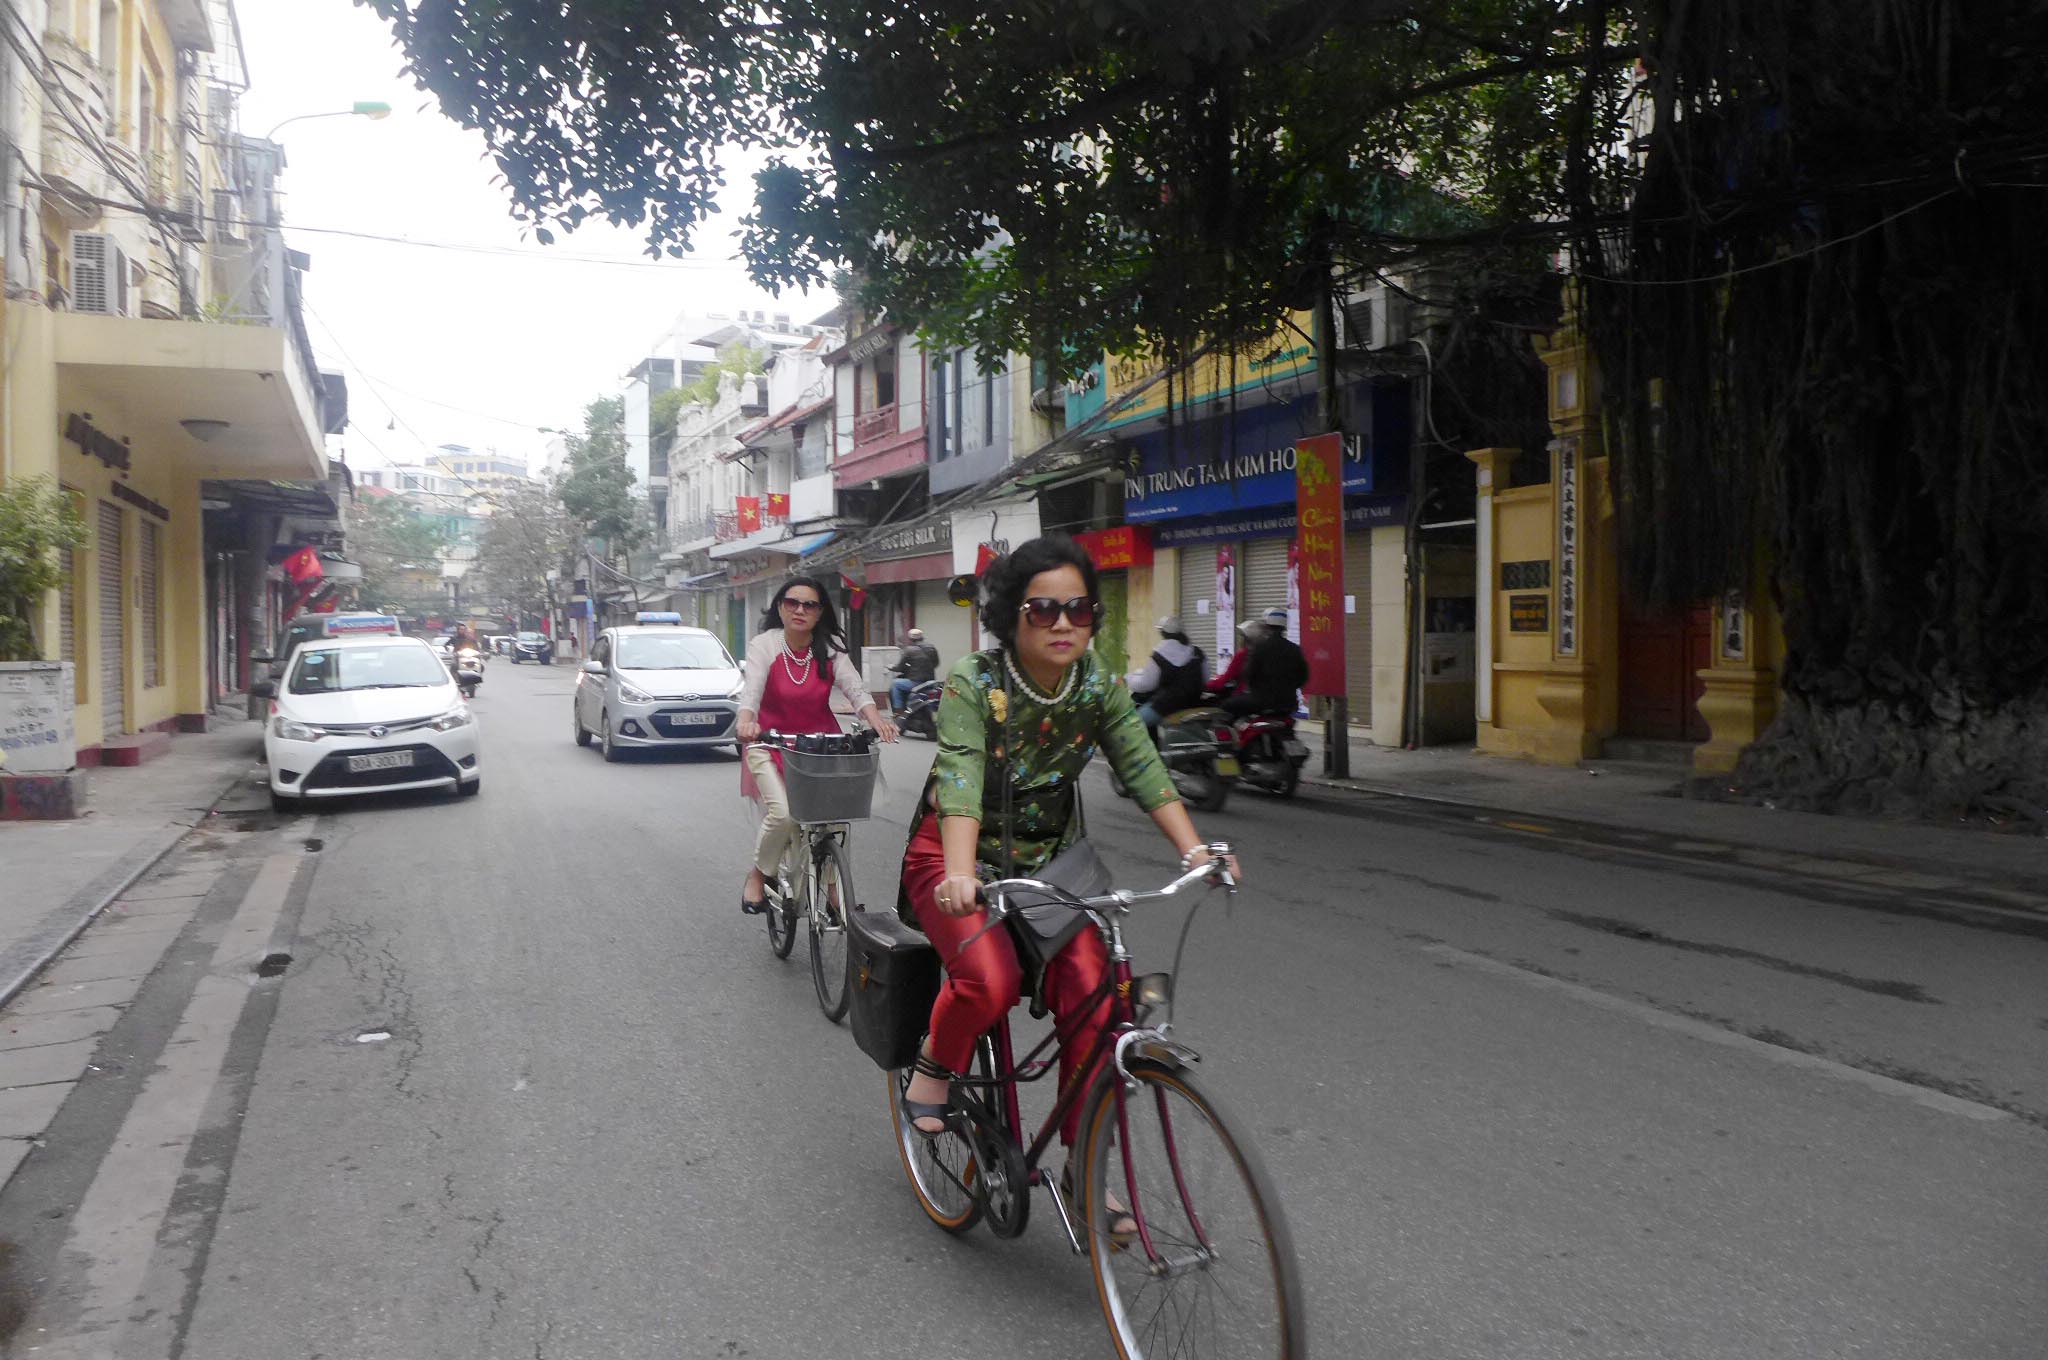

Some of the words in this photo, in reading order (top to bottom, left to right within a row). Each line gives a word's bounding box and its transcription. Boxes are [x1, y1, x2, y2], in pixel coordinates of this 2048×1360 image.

[1124, 477, 1145, 501] PNJ
[1149, 466, 1195, 493] TRUNG
[1234, 452, 1265, 481] KIM
[1345, 434, 1362, 463] NJ
